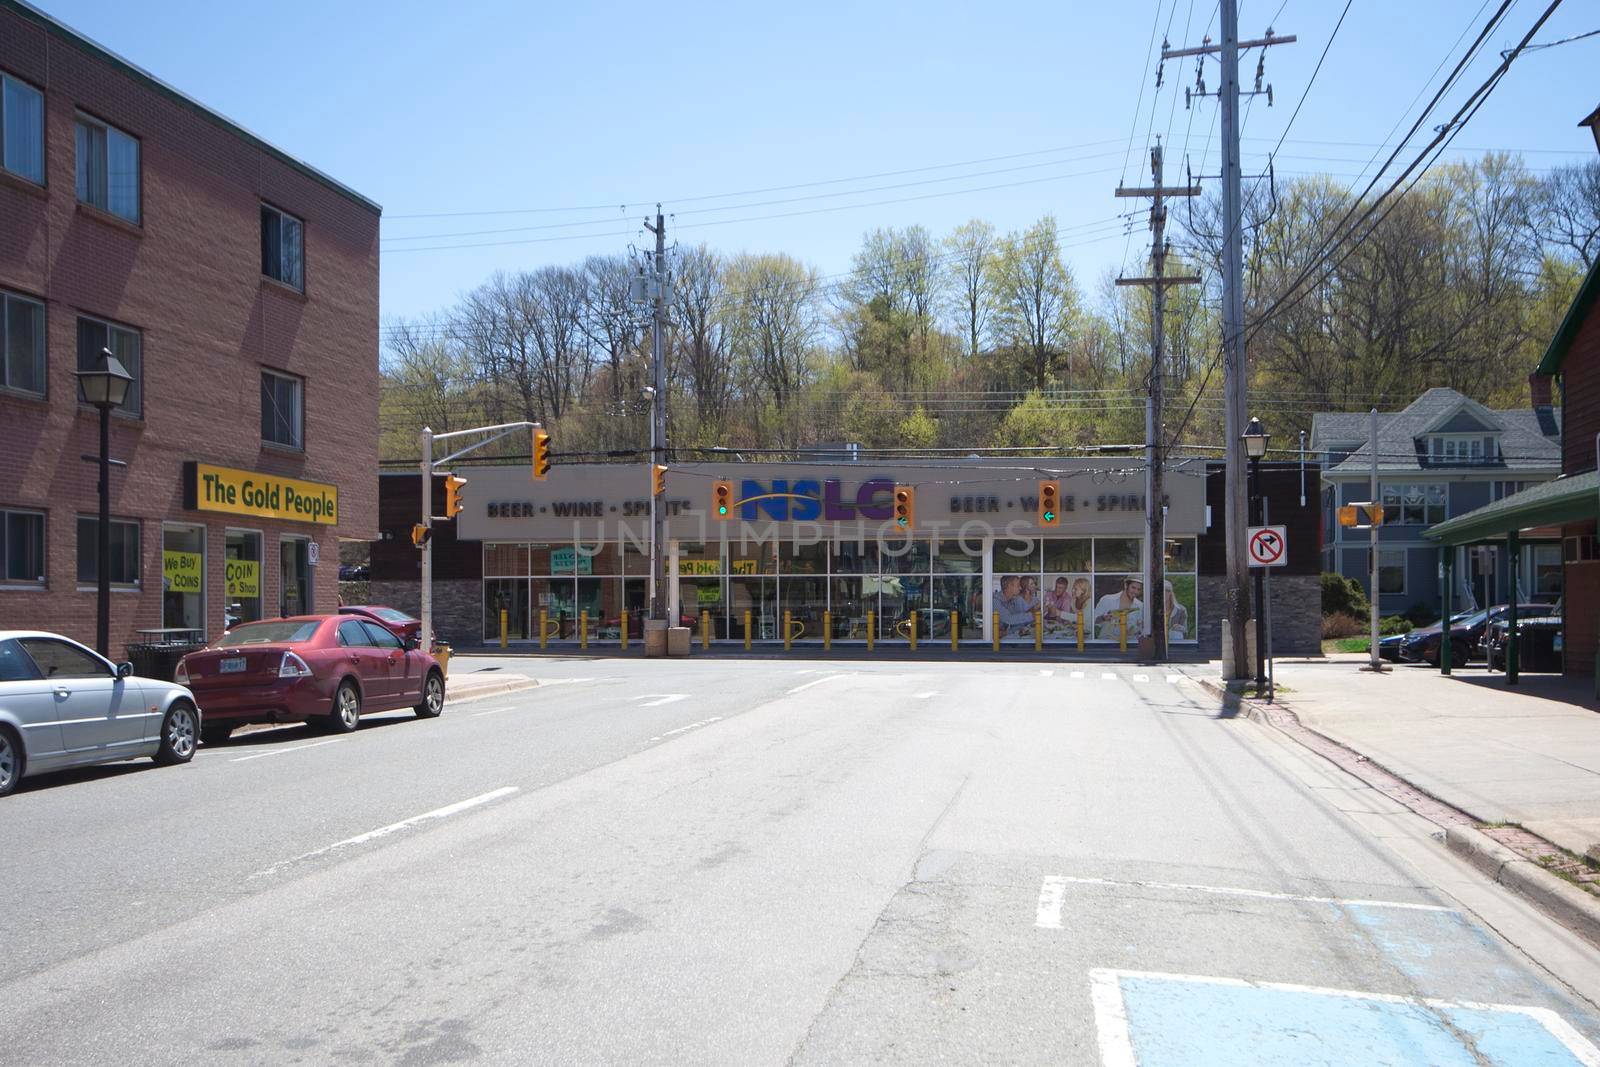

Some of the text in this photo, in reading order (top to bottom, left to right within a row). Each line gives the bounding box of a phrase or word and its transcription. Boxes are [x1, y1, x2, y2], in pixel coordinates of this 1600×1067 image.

[203, 473, 334, 522] The Gold People
[740, 478, 895, 522] NSLC
[950, 496, 1000, 512] BEER
[1020, 496, 1075, 512] WE
[487, 500, 691, 518] BEER WINE SPIITS
[164, 556, 196, 571] We Buy
[173, 574, 199, 588] COINS
[225, 563, 254, 582] COIN
[239, 581, 257, 594] Shop
